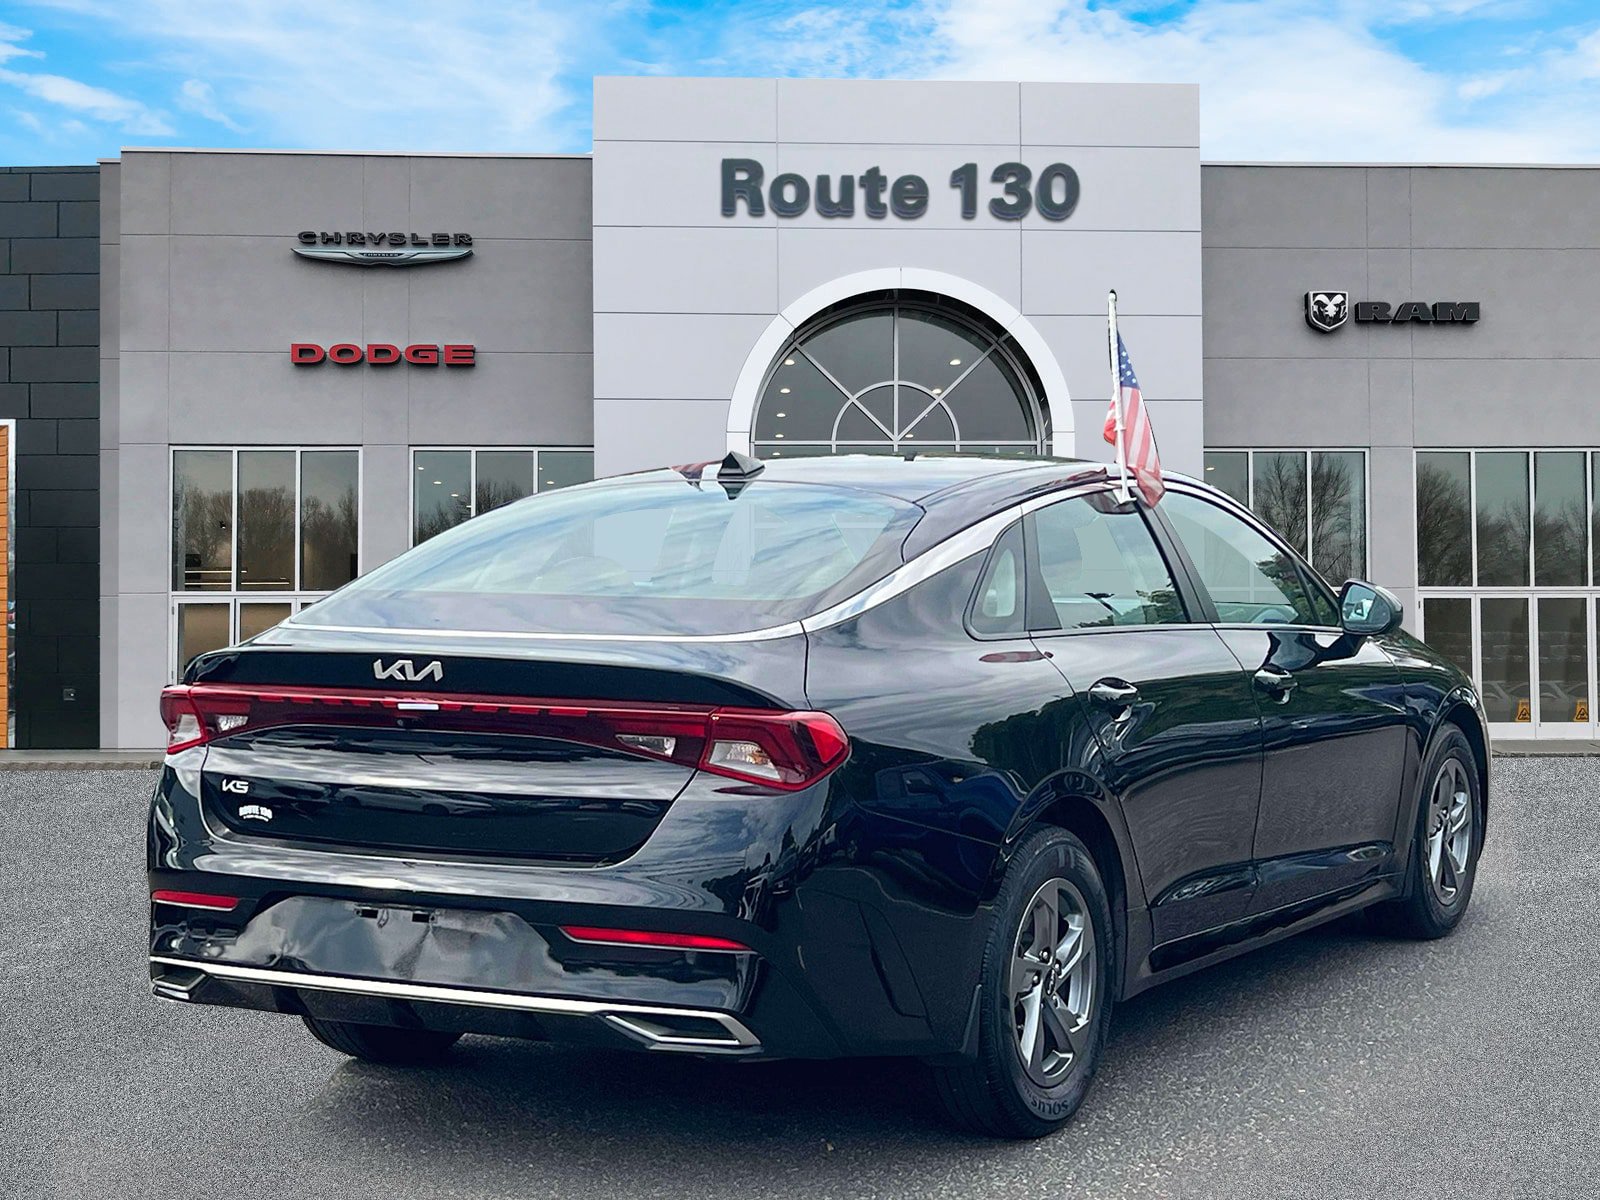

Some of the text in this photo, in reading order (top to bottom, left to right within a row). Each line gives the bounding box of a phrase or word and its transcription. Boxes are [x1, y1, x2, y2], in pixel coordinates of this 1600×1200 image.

[721, 158, 1080, 221] Route 130
[298, 231, 472, 245] CHRYSLER
[1355, 302, 1480, 323] RAM
[291, 343, 475, 365] DODGE
[373, 658, 443, 682] KIA
[222, 779, 249, 794] K5
[1031, 1097, 1069, 1115] SOLUS
